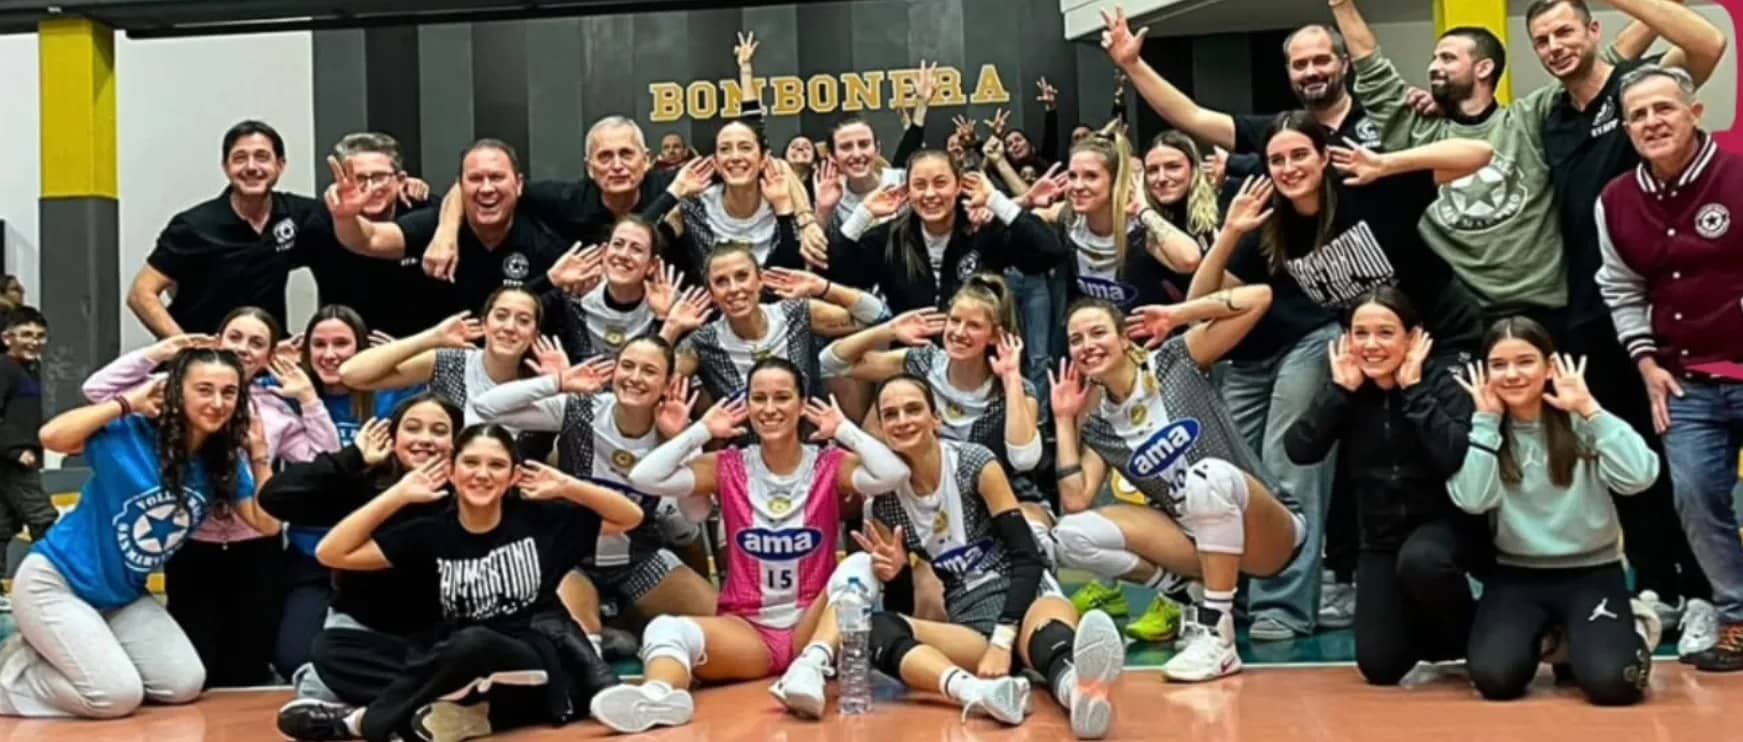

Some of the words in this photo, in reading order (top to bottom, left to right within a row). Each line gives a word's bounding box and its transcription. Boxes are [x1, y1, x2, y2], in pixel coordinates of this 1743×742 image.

[650, 64, 1010, 121] BOMBONERA
[1133, 425, 1192, 475] ama
[743, 531, 813, 553] ama
[767, 569, 792, 588] 15
